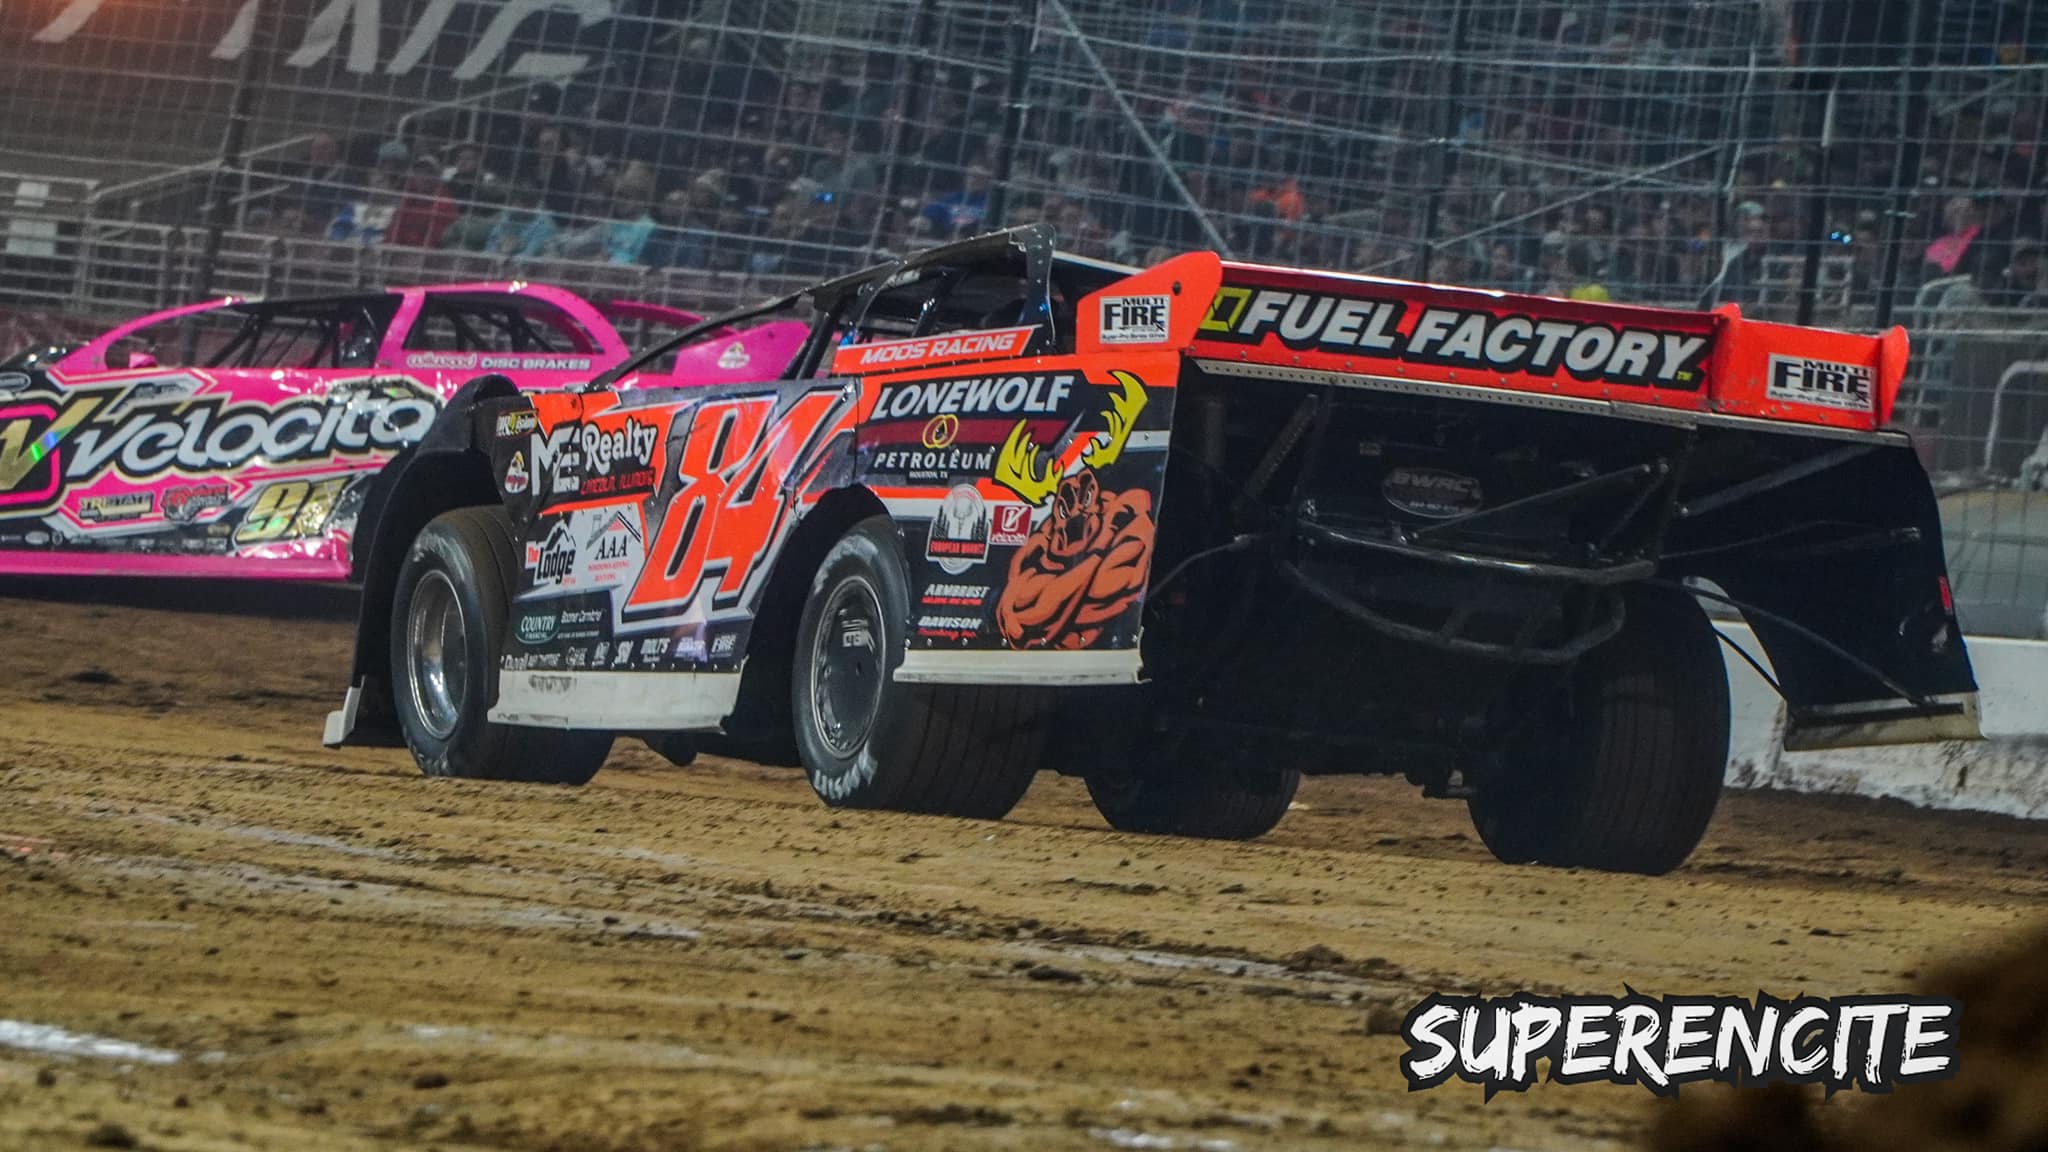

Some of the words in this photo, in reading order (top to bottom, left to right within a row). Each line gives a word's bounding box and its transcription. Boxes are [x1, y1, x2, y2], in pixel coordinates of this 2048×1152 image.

[1122, 297, 1165, 306] MULTI
[1104, 303, 1166, 330] FIRE
[928, 333, 1017, 357] RACING
[1238, 289, 1396, 349] FUEL
[1406, 308, 1706, 380] FACTORY
[480, 357, 520, 369] DISC
[522, 358, 591, 370] BRAKES
[1803, 360, 1868, 376] MULTI
[1774, 361, 1869, 393] FIRE
[869, 375, 1075, 420] LONEWOLF
[66, 390, 436, 478] Velocita
[582, 419, 657, 475] Realty
[874, 452, 993, 471] PETROLEUM
[624, 391, 843, 609] 84
[595, 535, 628, 560] AAA
[537, 543, 577, 585] Lodge
[520, 615, 557, 632] COUNTRY
[917, 615, 983, 630] DAVISON
